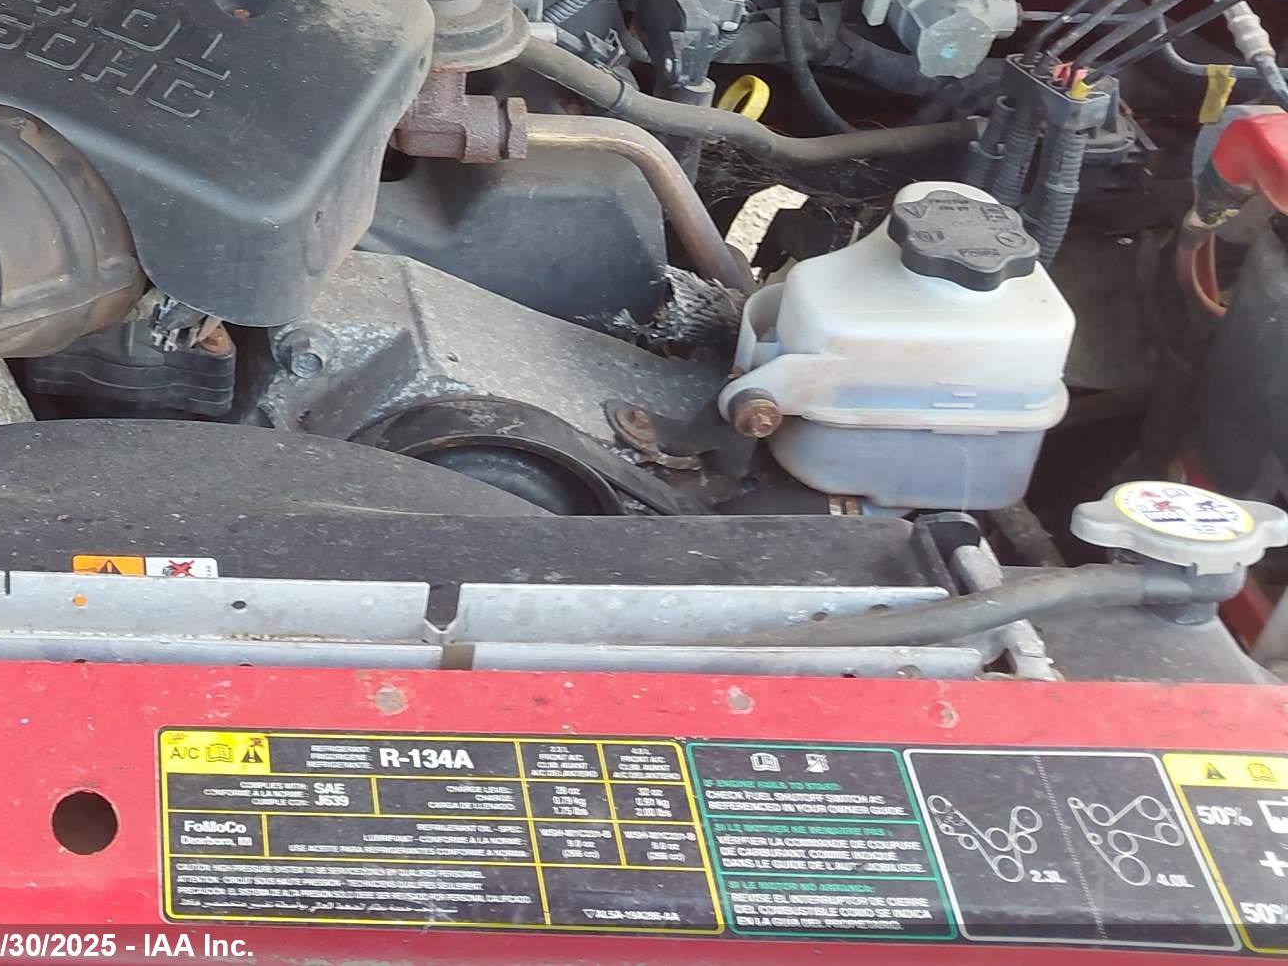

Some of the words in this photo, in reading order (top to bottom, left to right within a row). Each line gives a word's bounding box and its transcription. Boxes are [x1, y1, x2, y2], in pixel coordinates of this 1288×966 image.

[170, 746, 200, 760] A/C
[379, 747, 475, 770] R-134A
[313, 782, 345, 795] SAE
[1195, 805, 1253, 827] 50%
[183, 820, 247, 834] FoMoCo
[1029, 869, 1068, 884] 2.3L
